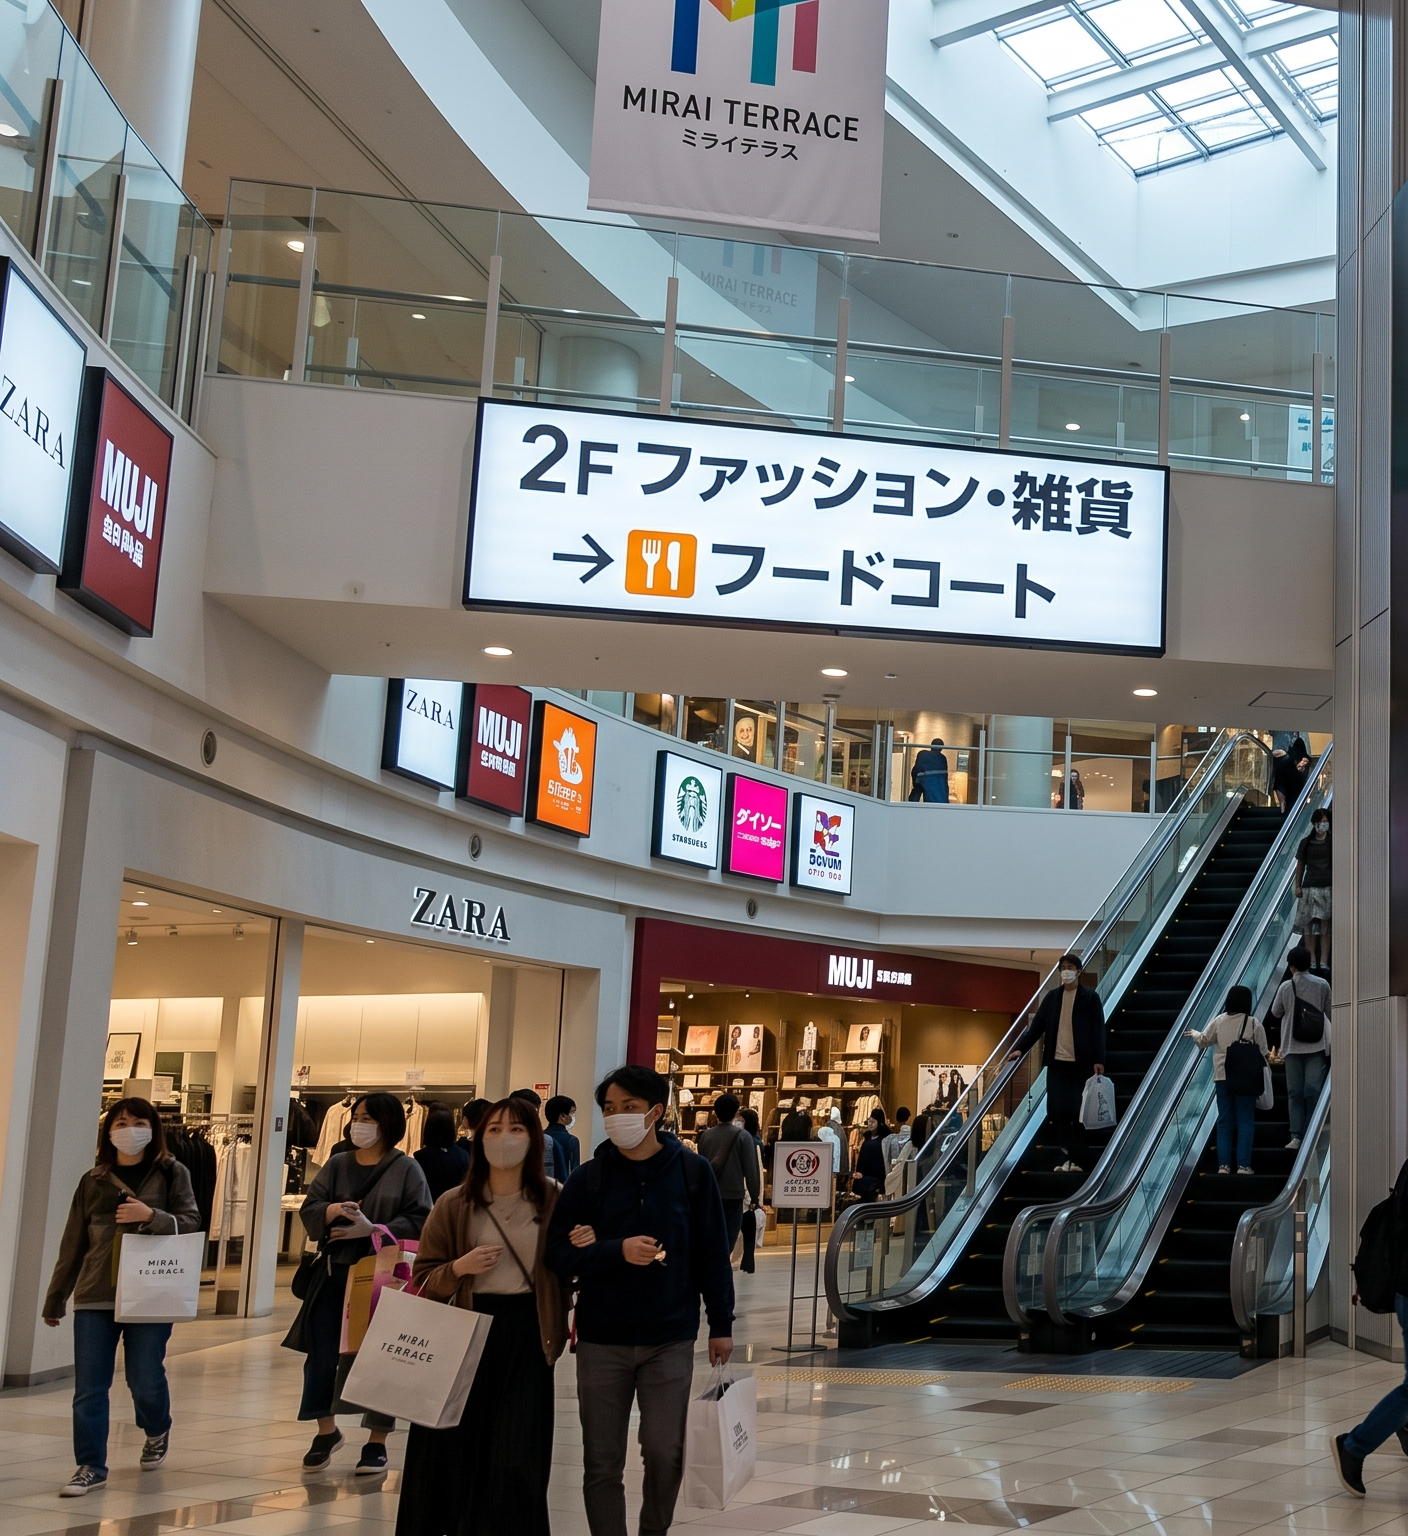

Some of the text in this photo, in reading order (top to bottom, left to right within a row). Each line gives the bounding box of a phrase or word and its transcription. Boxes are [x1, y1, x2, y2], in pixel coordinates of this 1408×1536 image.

[622, 85, 860, 142] MIRAI TERRACE
[682, 128, 799, 161] ミライテラス
[0, 374, 66, 470] ZARA
[100, 438, 158, 541] MUJI
[710, 542, 1056, 619] フードコート
[406, 689, 455, 730] ZARA
[477, 706, 523, 760] MUJI
[736, 808, 782, 832] ダイソー
[410, 886, 511, 943] ZARA
[828, 954, 874, 990] MUJI
[148, 1259, 178, 1267] MIRAI
[381, 1342, 434, 1363] TERRACE
